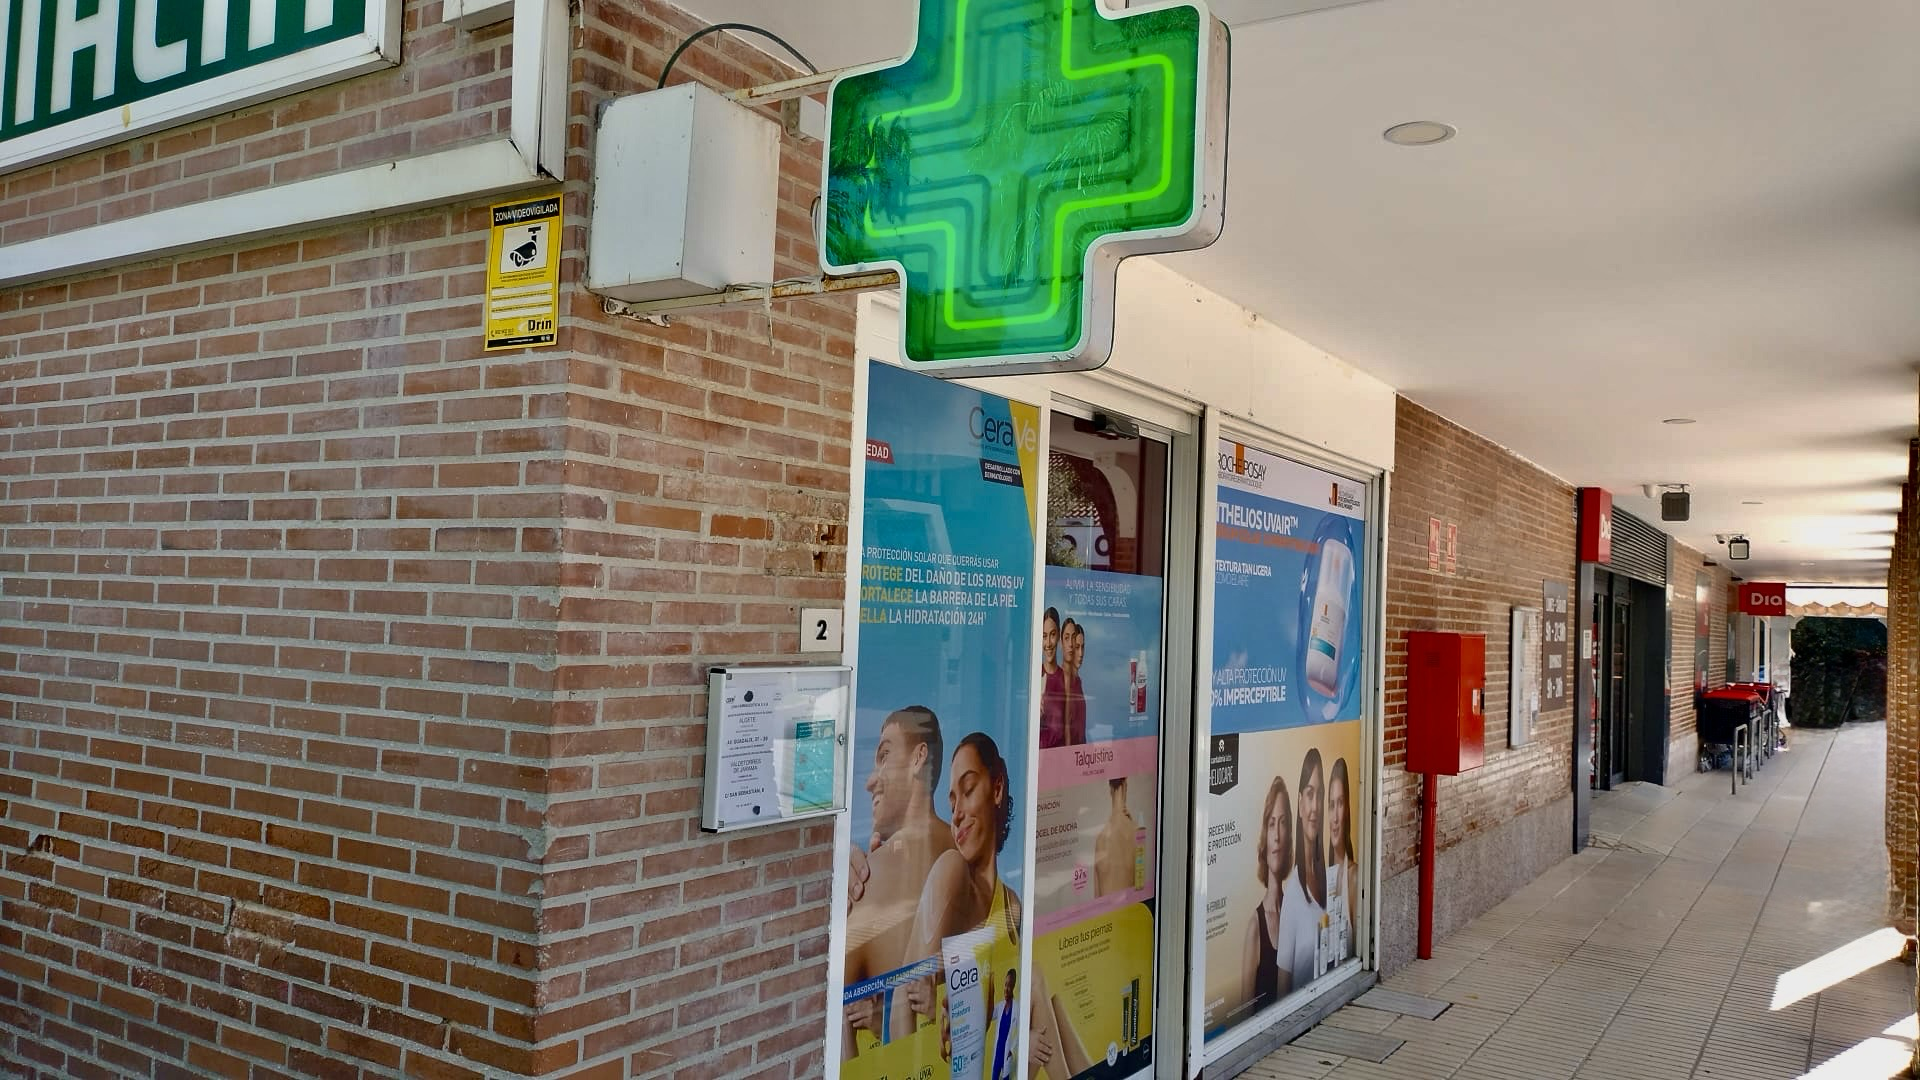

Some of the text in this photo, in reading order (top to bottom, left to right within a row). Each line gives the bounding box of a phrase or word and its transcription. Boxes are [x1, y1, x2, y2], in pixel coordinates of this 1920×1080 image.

[528, 318, 552, 331] Drin
[969, 406, 1037, 453] CeraVe
[866, 443, 889, 460] EDAD
[867, 547, 913, 561] PROTECCIÓN
[914, 551, 937, 564] SOLAR
[937, 553, 952, 565] QUE
[952, 554, 982, 568] QUERRÁS
[982, 558, 999, 569] USAR
[905, 567, 924, 583] DEL
[926, 566, 952, 585] DAÑO
[954, 572, 967, 586] DE
[967, 573, 984, 587] LOS
[985, 573, 1012, 589] RAYOS
[1013, 575, 1025, 590] UV
[915, 589, 928, 604] LA
[929, 590, 973, 606] BARRERA
[974, 592, 986, 607] DE
[987, 593, 999, 607] LA
[1000, 594, 1019, 608] PIEL
[1751, 592, 1783, 606] Dia
[888, 608, 901, 624] LA
[904, 606, 967, 625] HIDRATACIÓN
[816, 619, 828, 641] 2
[1223, 685, 1287, 706] IMPERCEPTIBLE
[1074, 748, 1114, 768] Talquistina
[1058, 922, 1113, 950] Libera tus piernas
